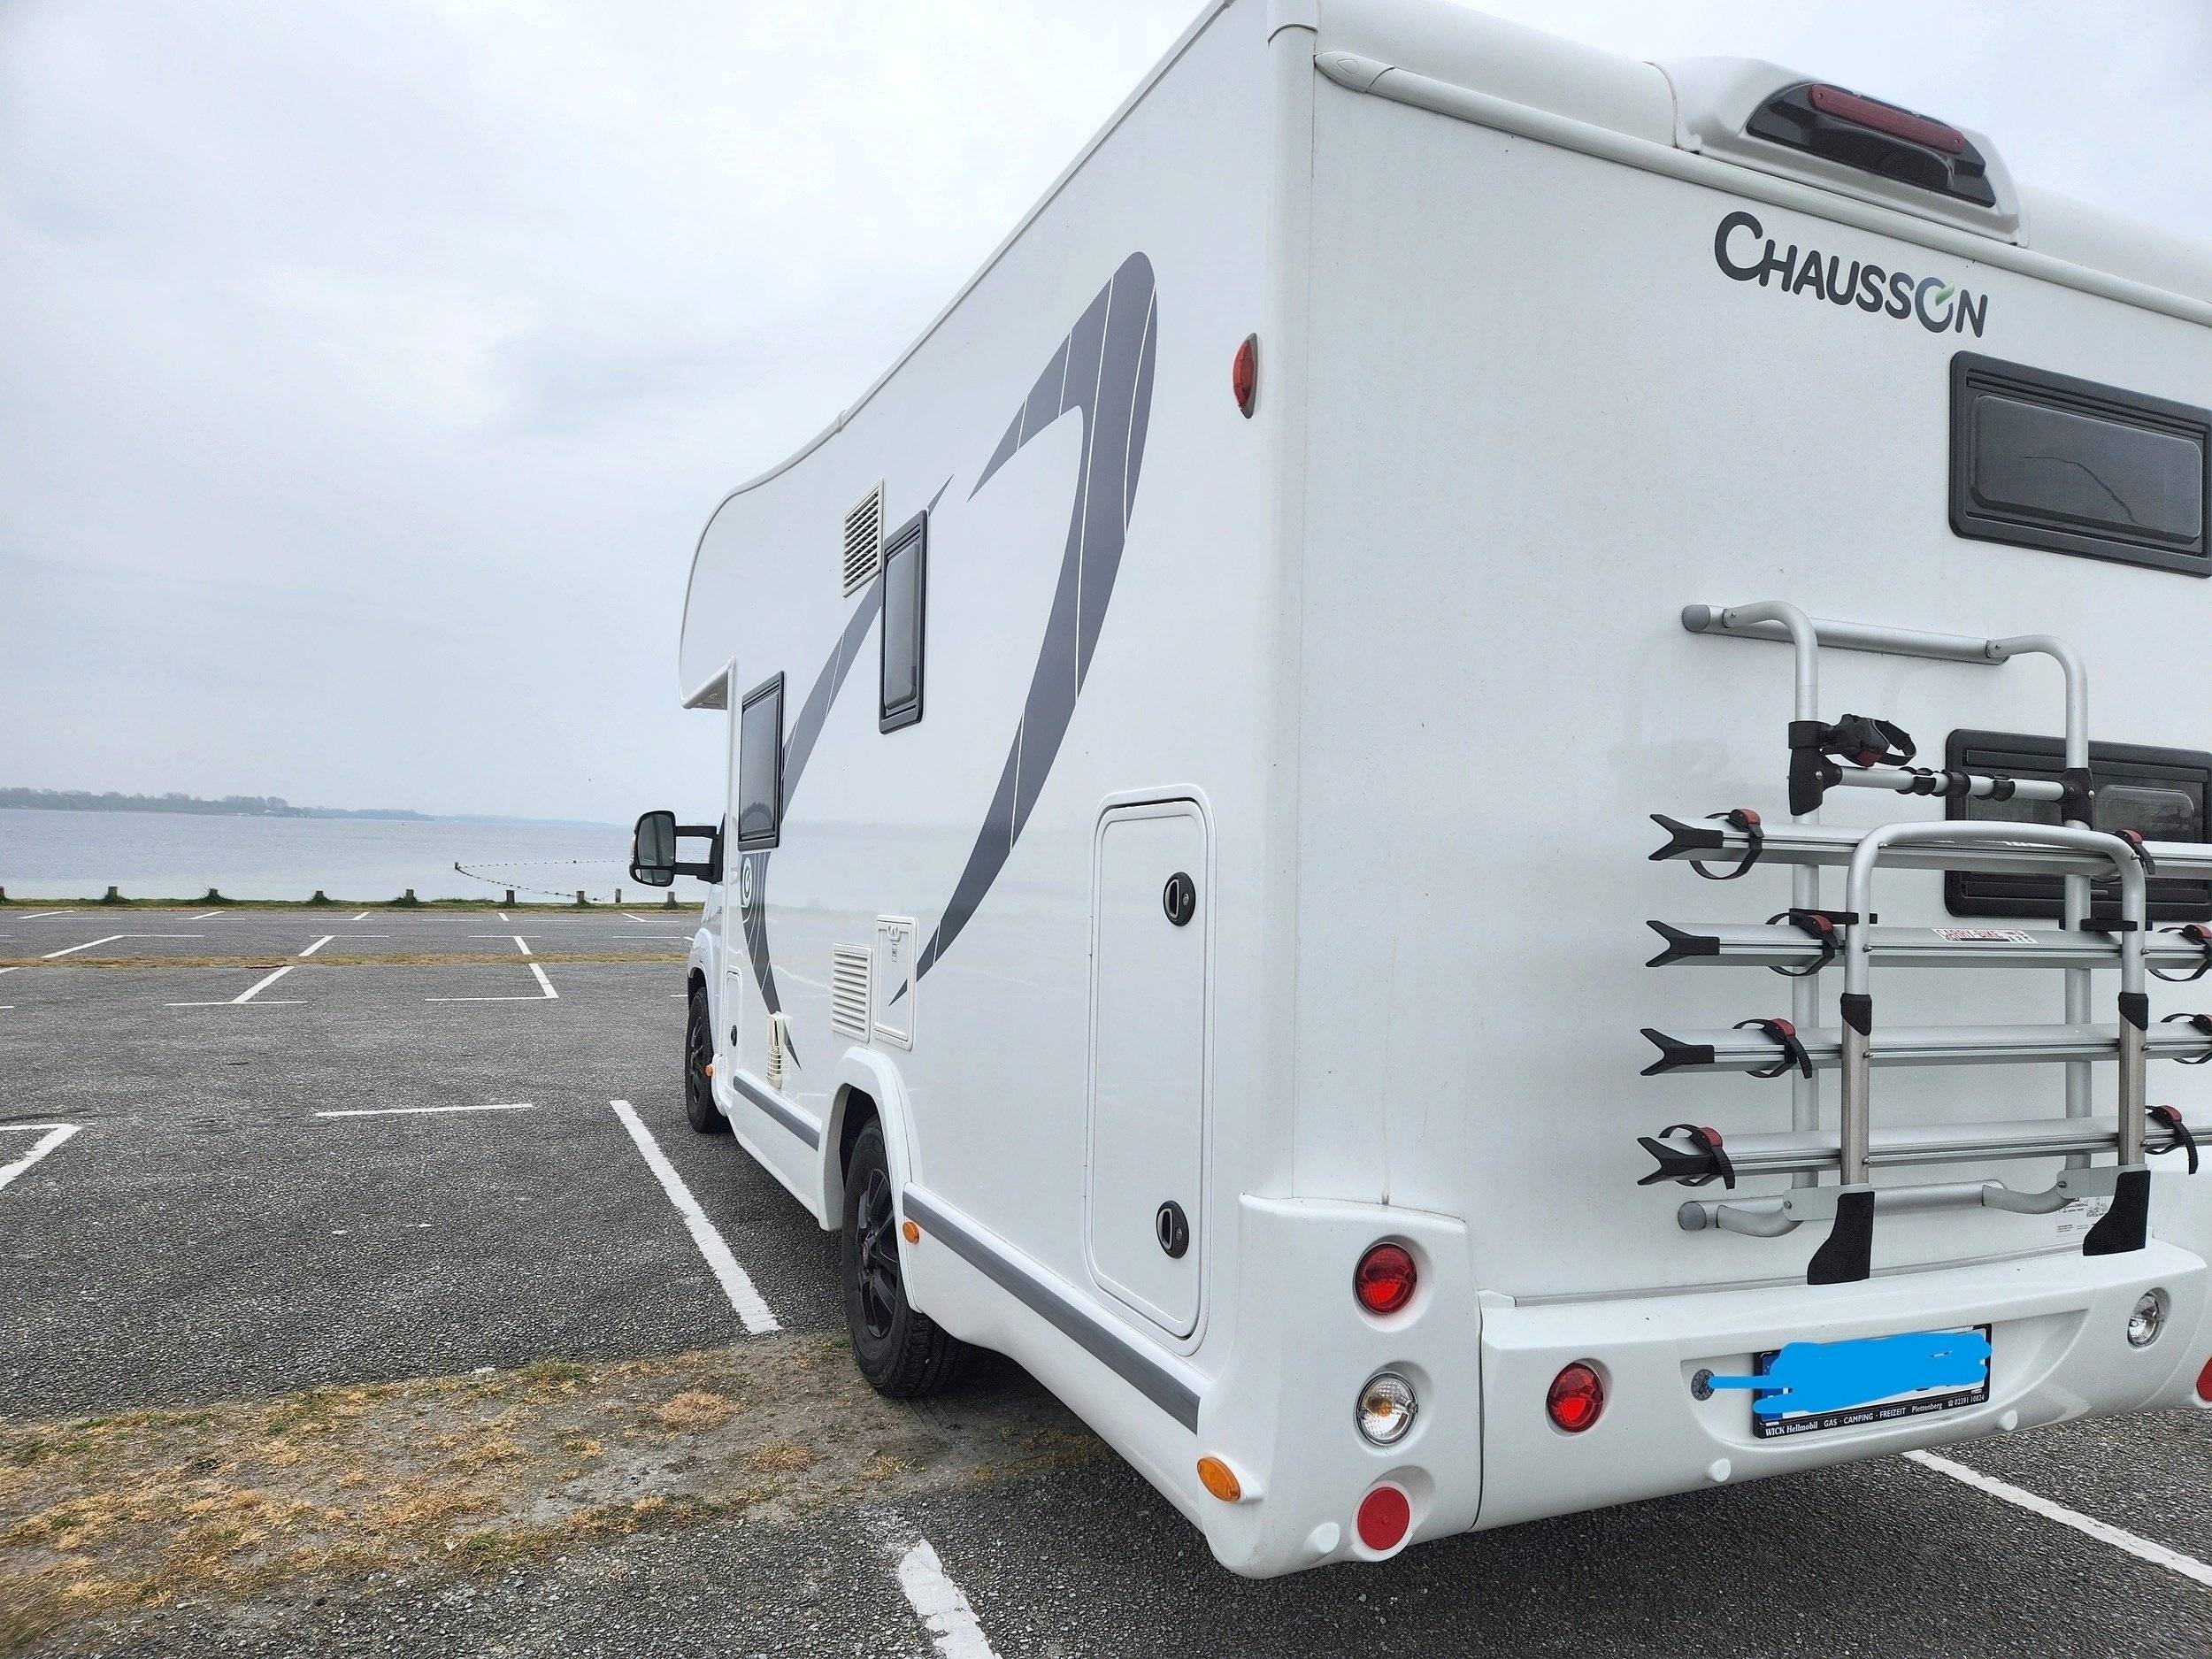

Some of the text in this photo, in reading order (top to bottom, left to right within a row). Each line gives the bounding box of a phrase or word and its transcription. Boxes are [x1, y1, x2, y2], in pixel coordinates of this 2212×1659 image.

[1714, 211, 1988, 338] CHAUSSON
[1765, 1426, 1785, 1437] WICK
[1824, 1418, 1838, 1427] GAS
[1843, 1413, 1874, 1425] CAMPING
[1879, 1407, 1906, 1418] FREIZEIT
[1911, 1402, 1943, 1413] Plettenberg
